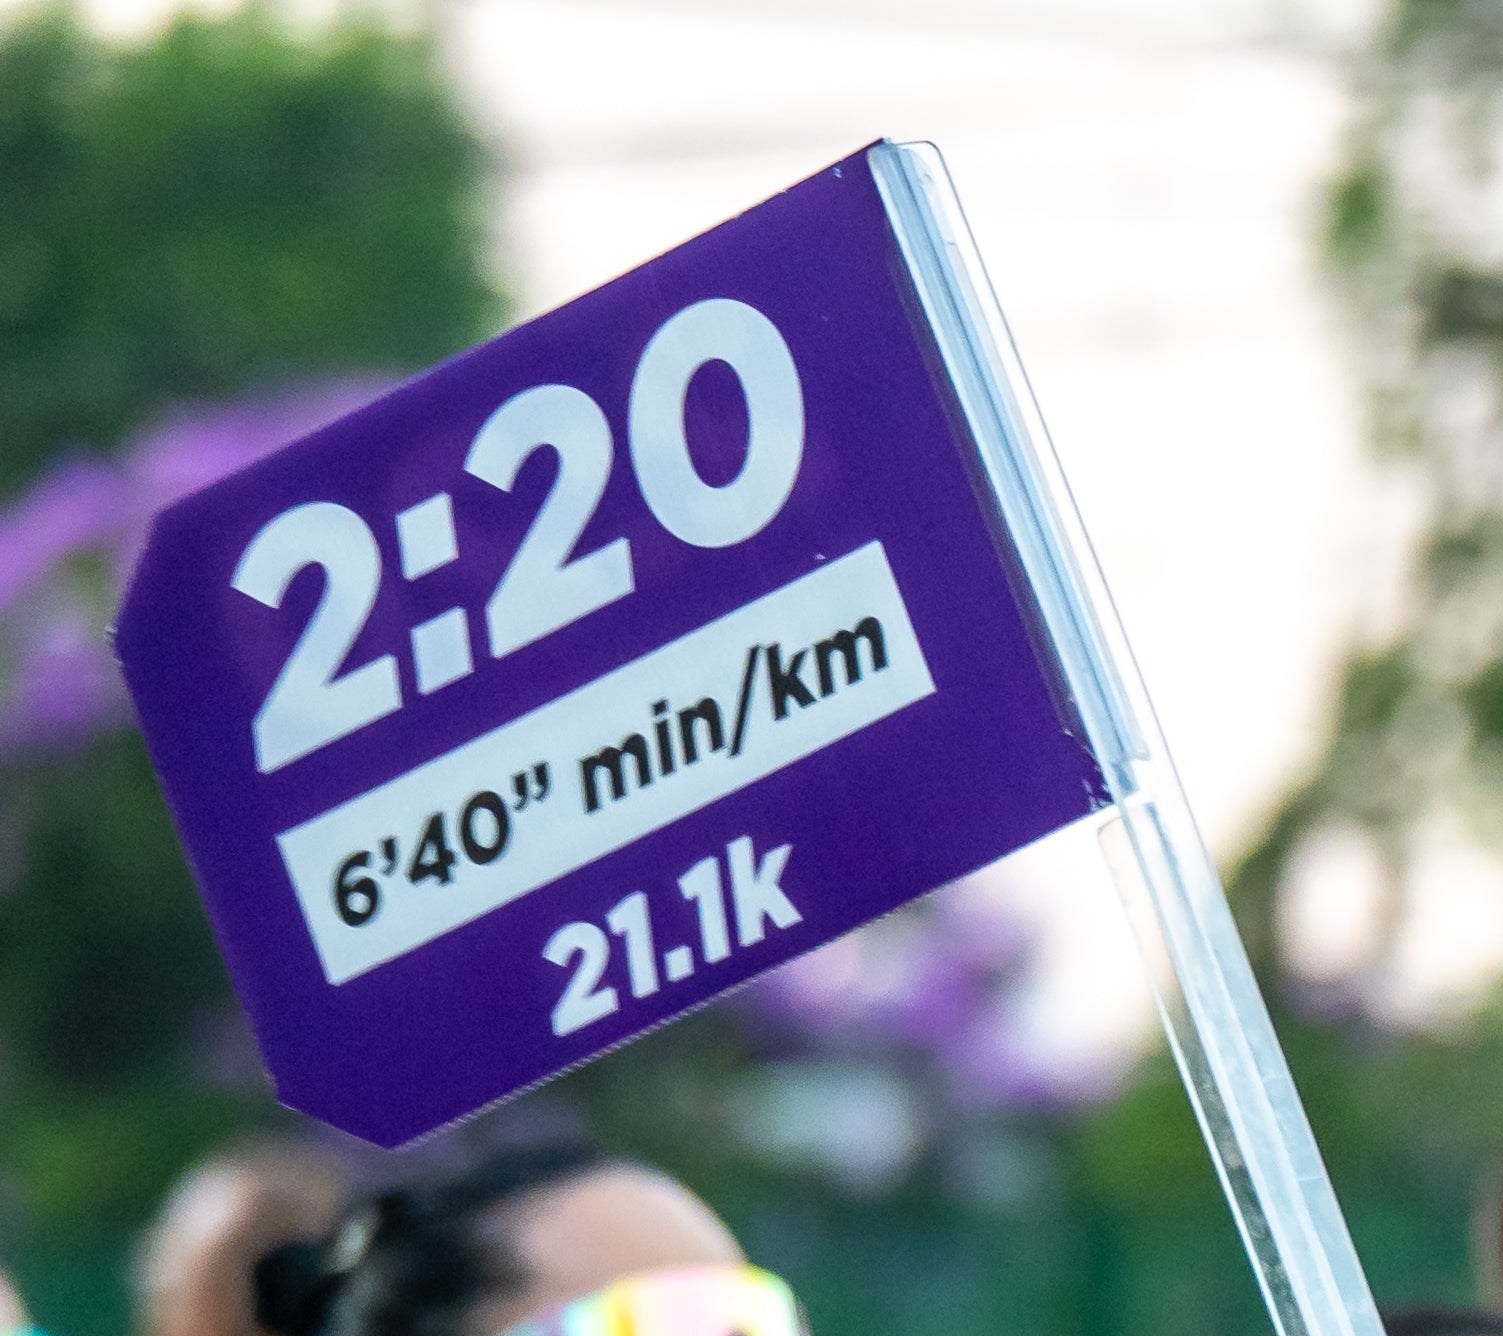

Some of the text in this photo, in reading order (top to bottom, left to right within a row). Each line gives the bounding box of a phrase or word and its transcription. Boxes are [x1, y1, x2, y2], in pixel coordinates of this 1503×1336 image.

[230, 298, 805, 774] 2:20
[580, 614, 887, 813] min/km
[540, 835, 804, 1037] 21.1k
